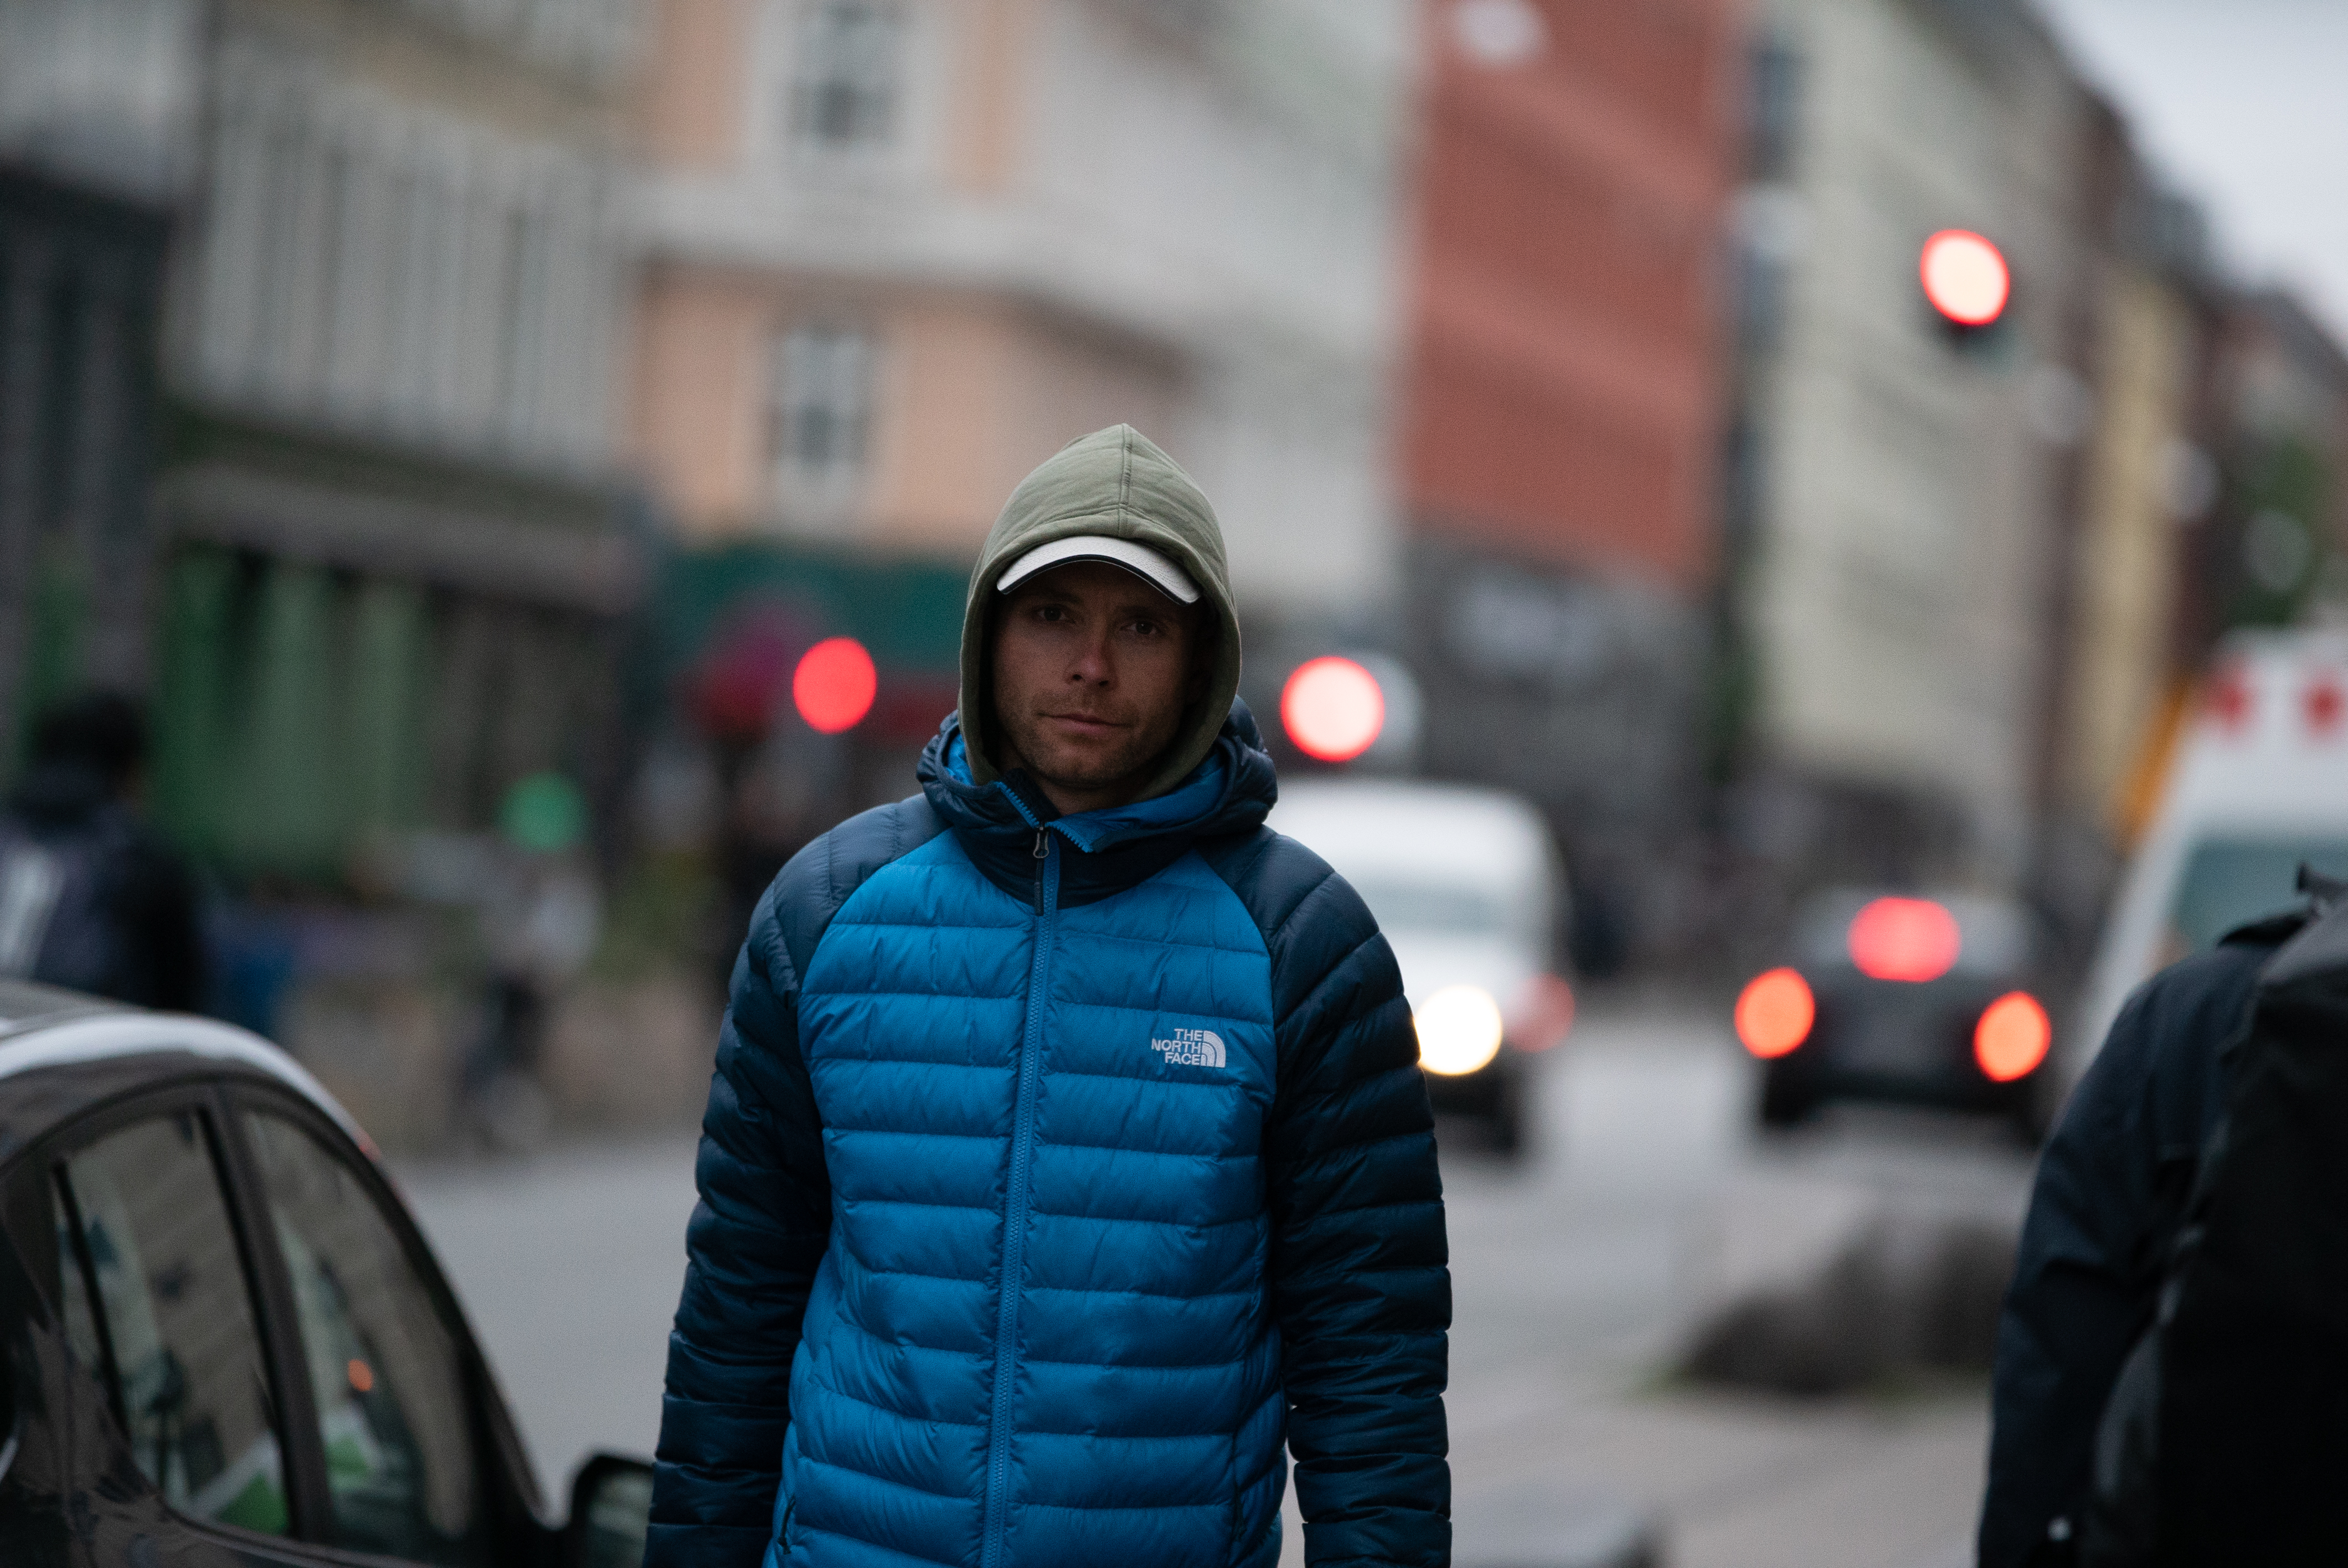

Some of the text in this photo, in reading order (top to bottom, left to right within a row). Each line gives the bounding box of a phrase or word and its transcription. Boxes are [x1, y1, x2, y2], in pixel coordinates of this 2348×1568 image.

[1174, 1028, 1203, 1041] THE
[1151, 1038, 1202, 1054] NORTH
[1165, 1052, 1201, 1066] FACE
